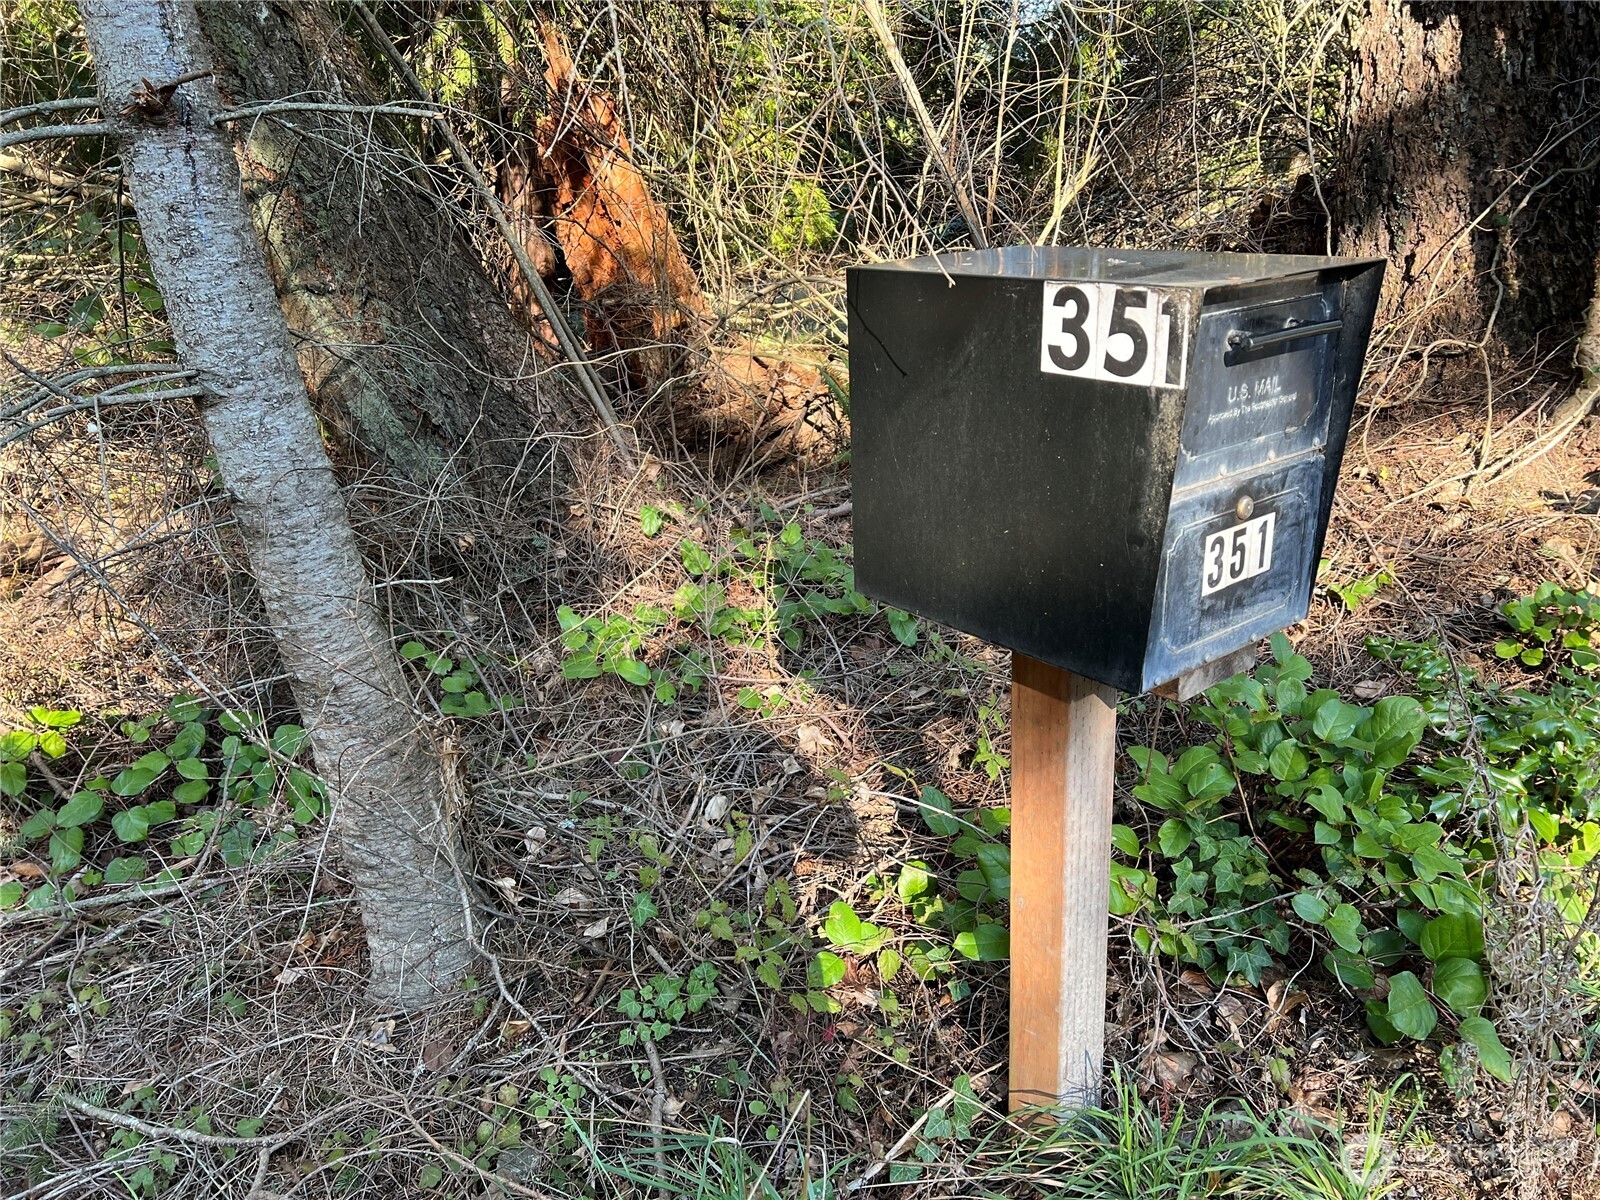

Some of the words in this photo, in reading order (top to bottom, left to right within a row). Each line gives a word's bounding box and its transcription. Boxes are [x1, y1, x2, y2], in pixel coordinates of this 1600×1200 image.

[1048, 286, 1187, 384] 351
[1228, 383, 1251, 403] U.S.
[1255, 375, 1281, 396] MAIL
[1207, 519, 1269, 588] 351
